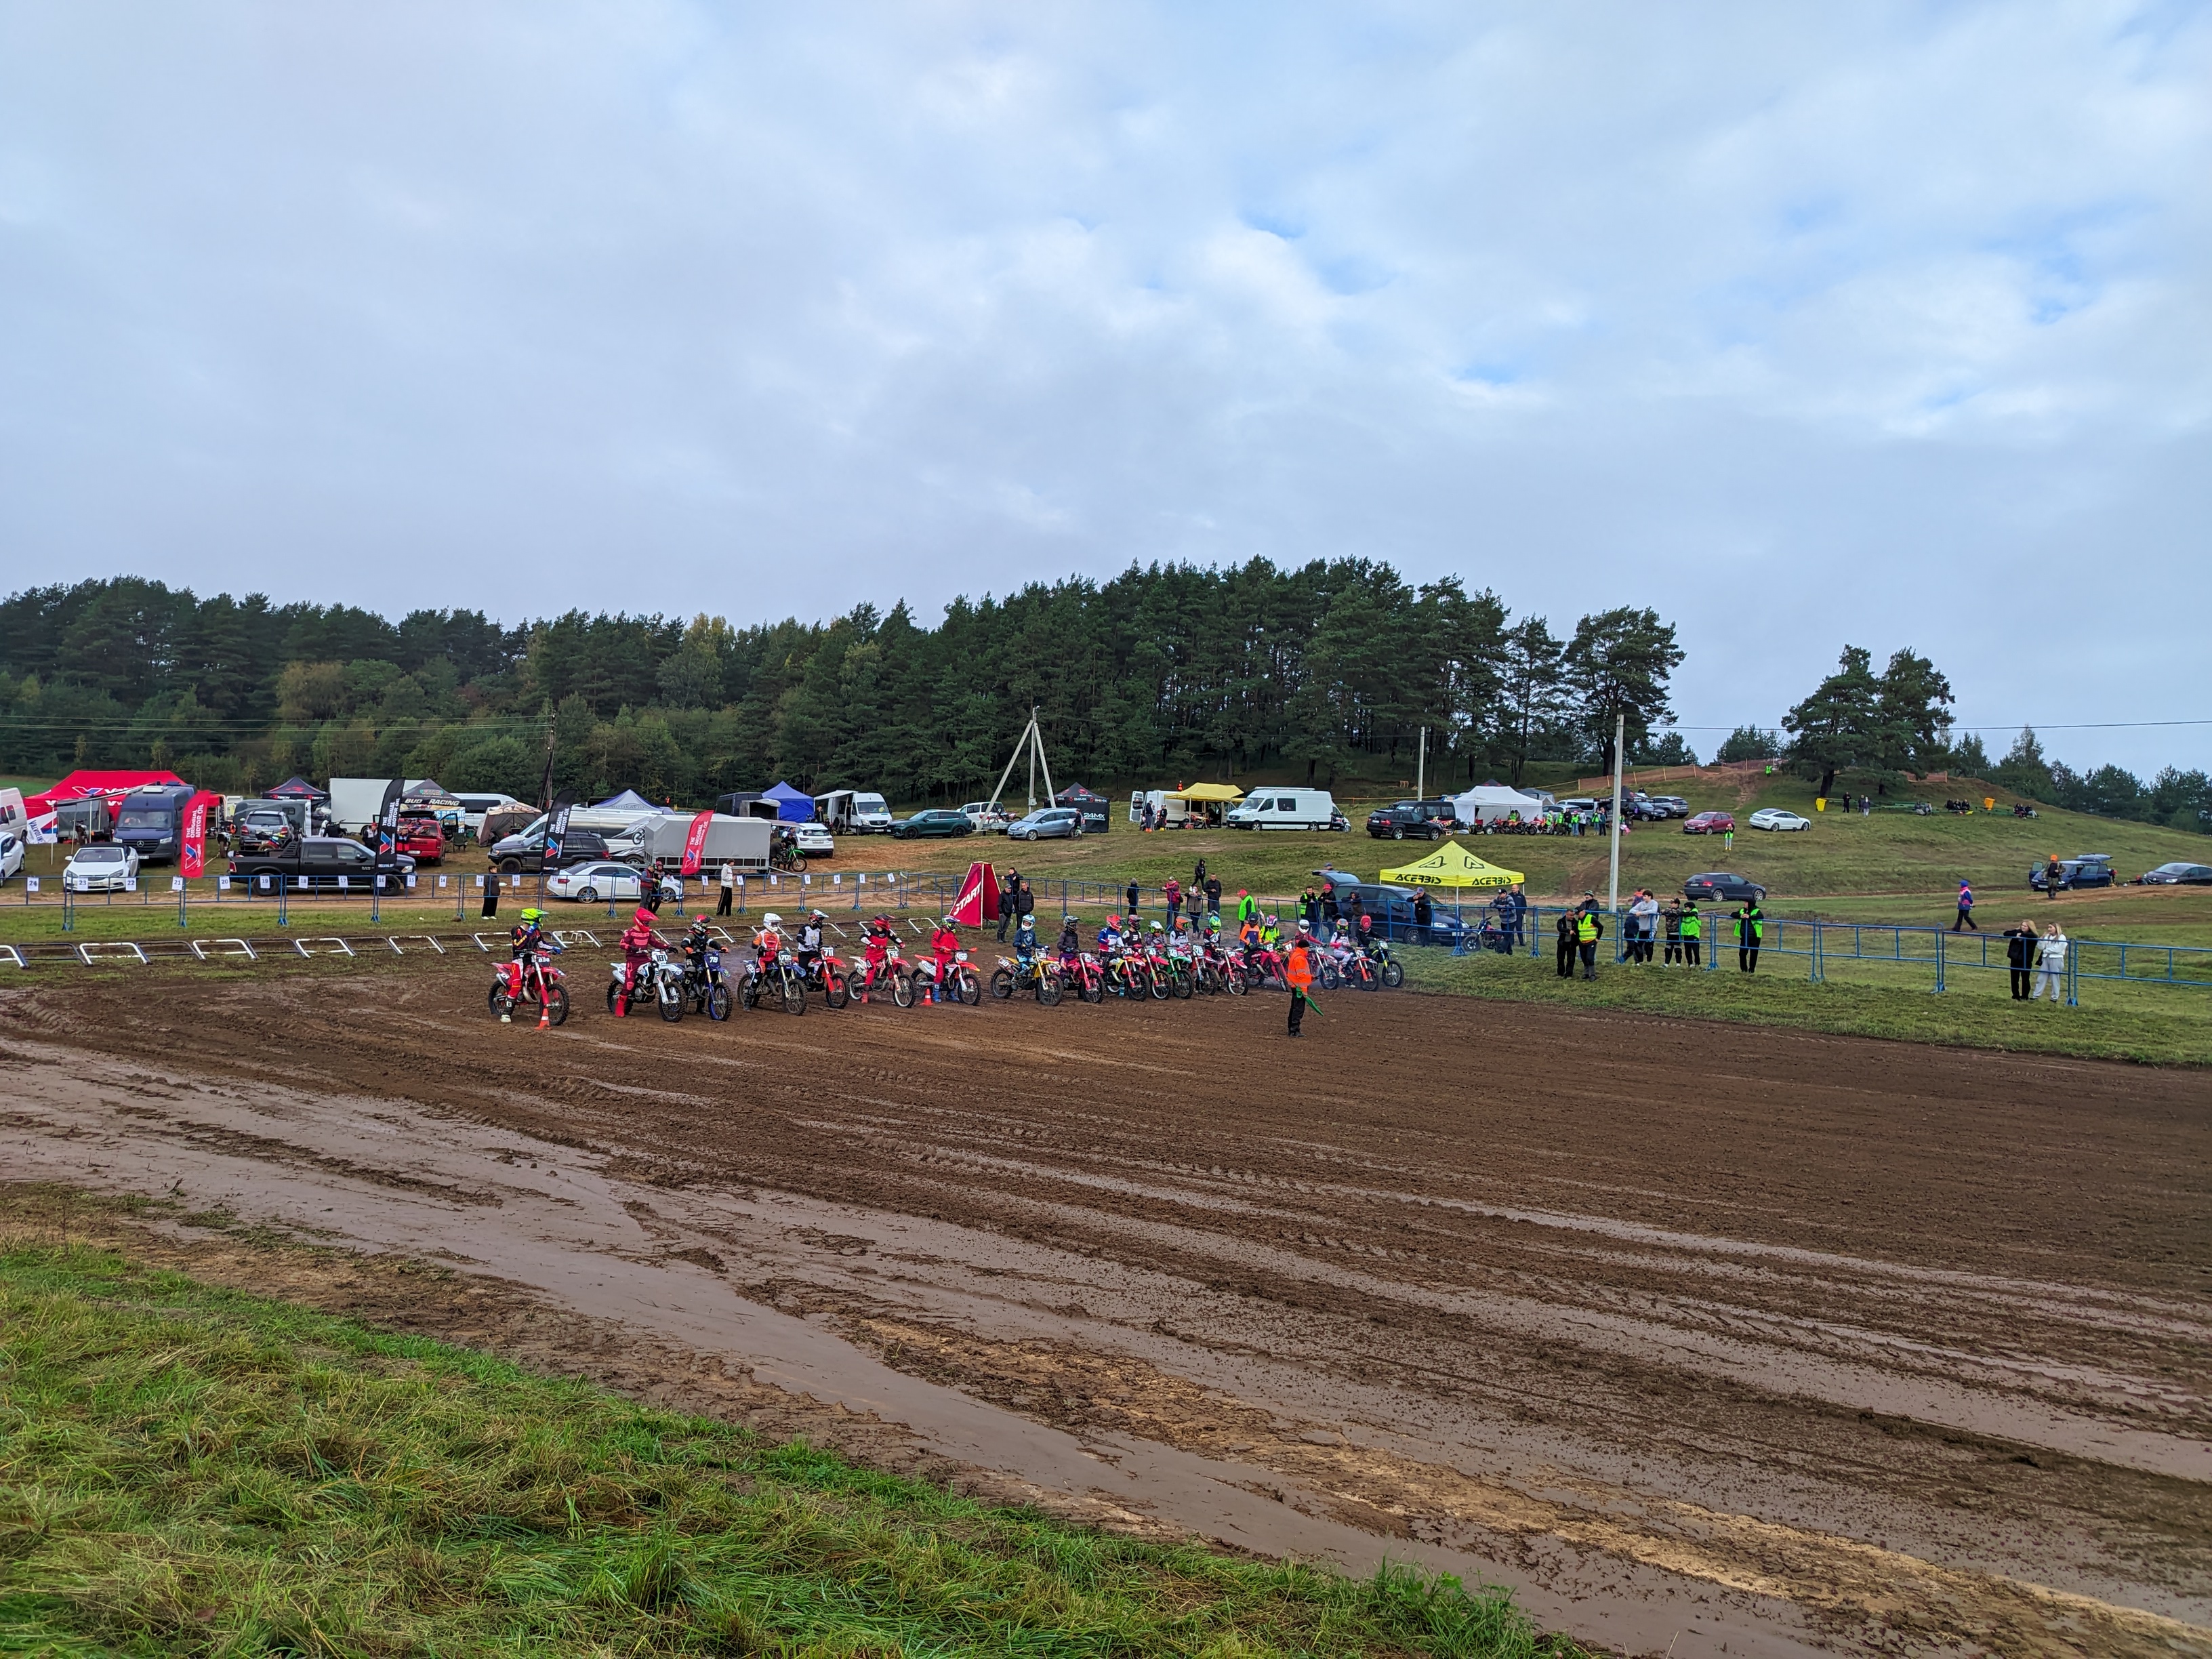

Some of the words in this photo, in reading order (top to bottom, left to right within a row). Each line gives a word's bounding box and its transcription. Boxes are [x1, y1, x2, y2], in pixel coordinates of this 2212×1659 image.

[387, 802, 395, 827] ORIGINAL
[555, 811, 564, 834] ORIGINAL
[695, 823, 703, 846] ORIGINAL
[953, 882, 981, 916] START
[1000, 959, 1010, 968] 30
